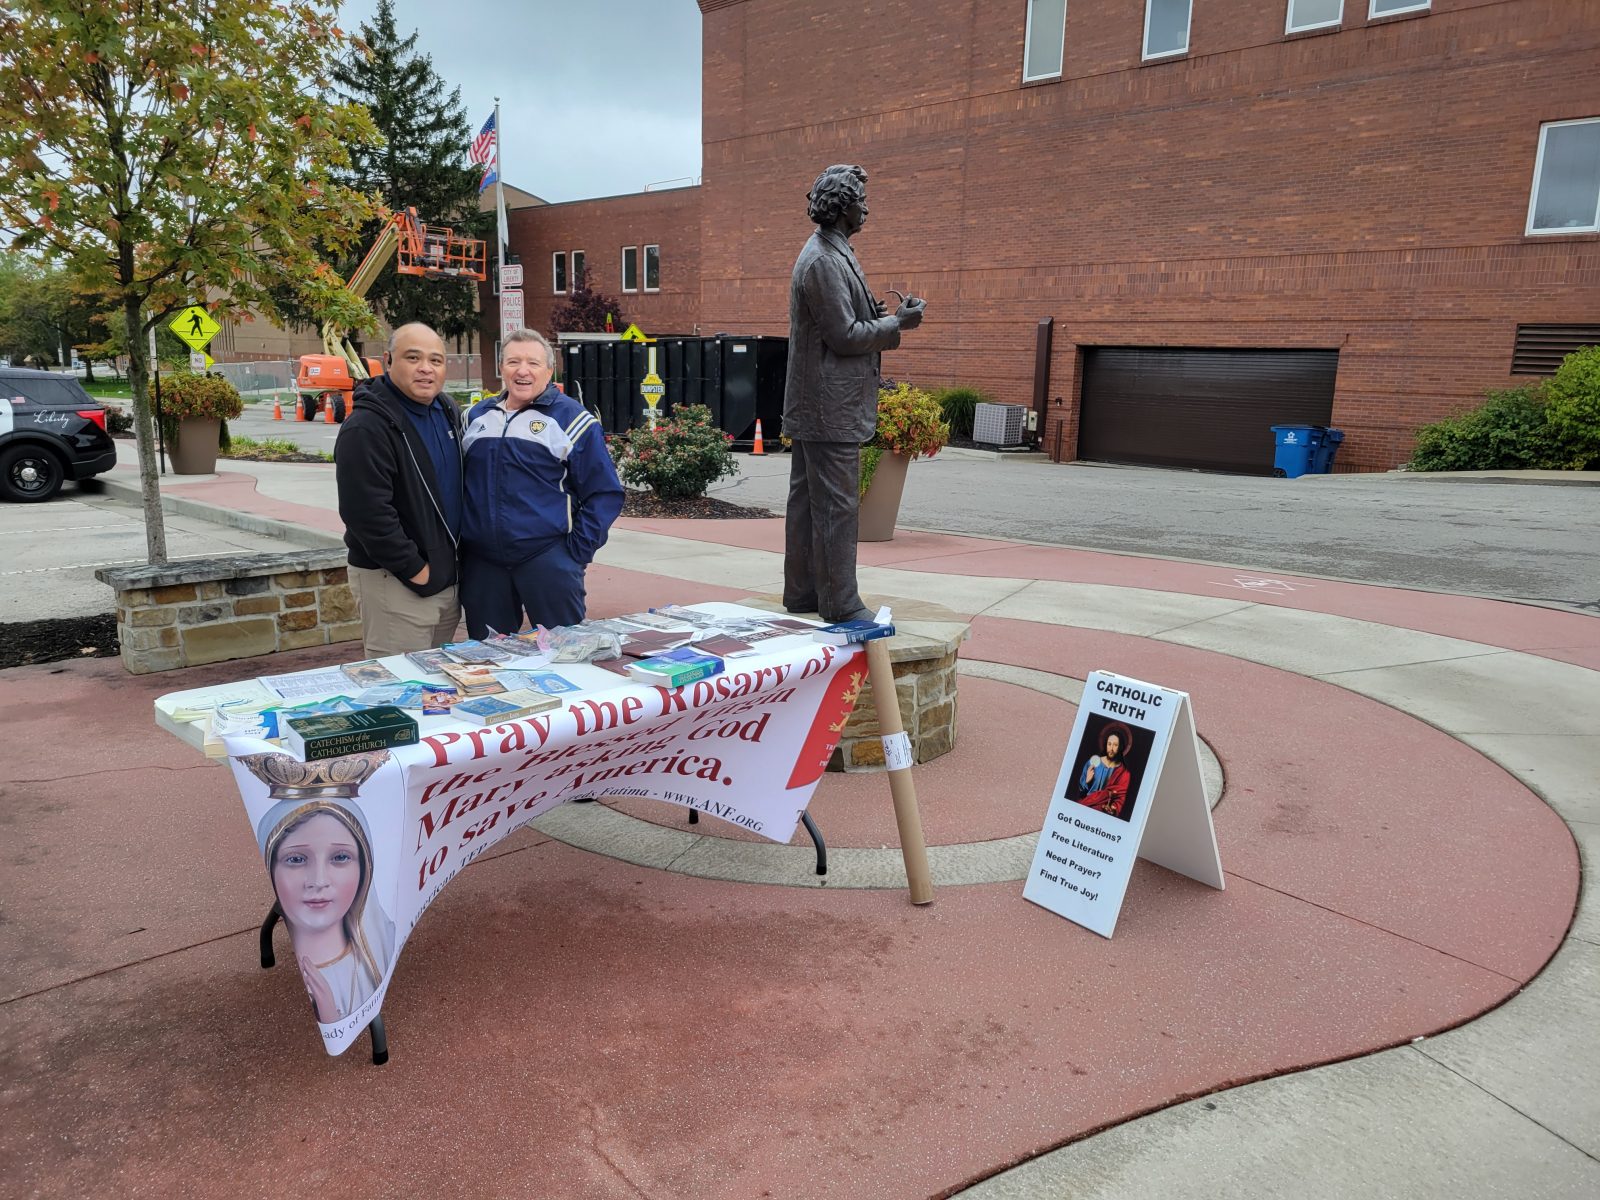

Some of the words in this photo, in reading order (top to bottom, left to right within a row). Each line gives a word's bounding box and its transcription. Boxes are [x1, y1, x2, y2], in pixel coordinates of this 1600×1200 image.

[503, 297, 521, 306] POLICE
[505, 323, 520, 331] ONLY
[33, 410, 70, 429] Liberty
[1096, 680, 1163, 707] CATHOLIC
[420, 714, 551, 769] Pray
[568, 696, 644, 737] the
[648, 664, 792, 718] Rosary
[800, 646, 836, 680] of
[1101, 698, 1146, 720] TRUTH
[310, 736, 355, 749] CATECHISM
[361, 732, 371, 741] the
[310, 744, 352, 759] CATHOLIC
[352, 739, 387, 752] CHURCH
[420, 767, 502, 805] the
[511, 715, 686, 774] Blessed
[414, 774, 539, 856] Mary
[543, 733, 681, 781] asking
[687, 712, 772, 743] God
[600, 786, 649, 796] Fatima
[418, 845, 449, 891] to
[458, 791, 548, 850] save
[551, 749, 733, 799] America.
[1057, 812, 1073, 824] Got
[1074, 819, 1122, 843] Questions?
[1051, 831, 1070, 845] Free
[1071, 839, 1114, 863] Literature
[1045, 850, 1067, 865] Need
[1068, 860, 1102, 880] Prayer?
[1039, 868, 1058, 883] Find
[1060, 877, 1079, 892] True
[1080, 888, 1099, 901] Joy!
[322, 1027, 345, 1039] ady
[349, 1013, 360, 1029] of
